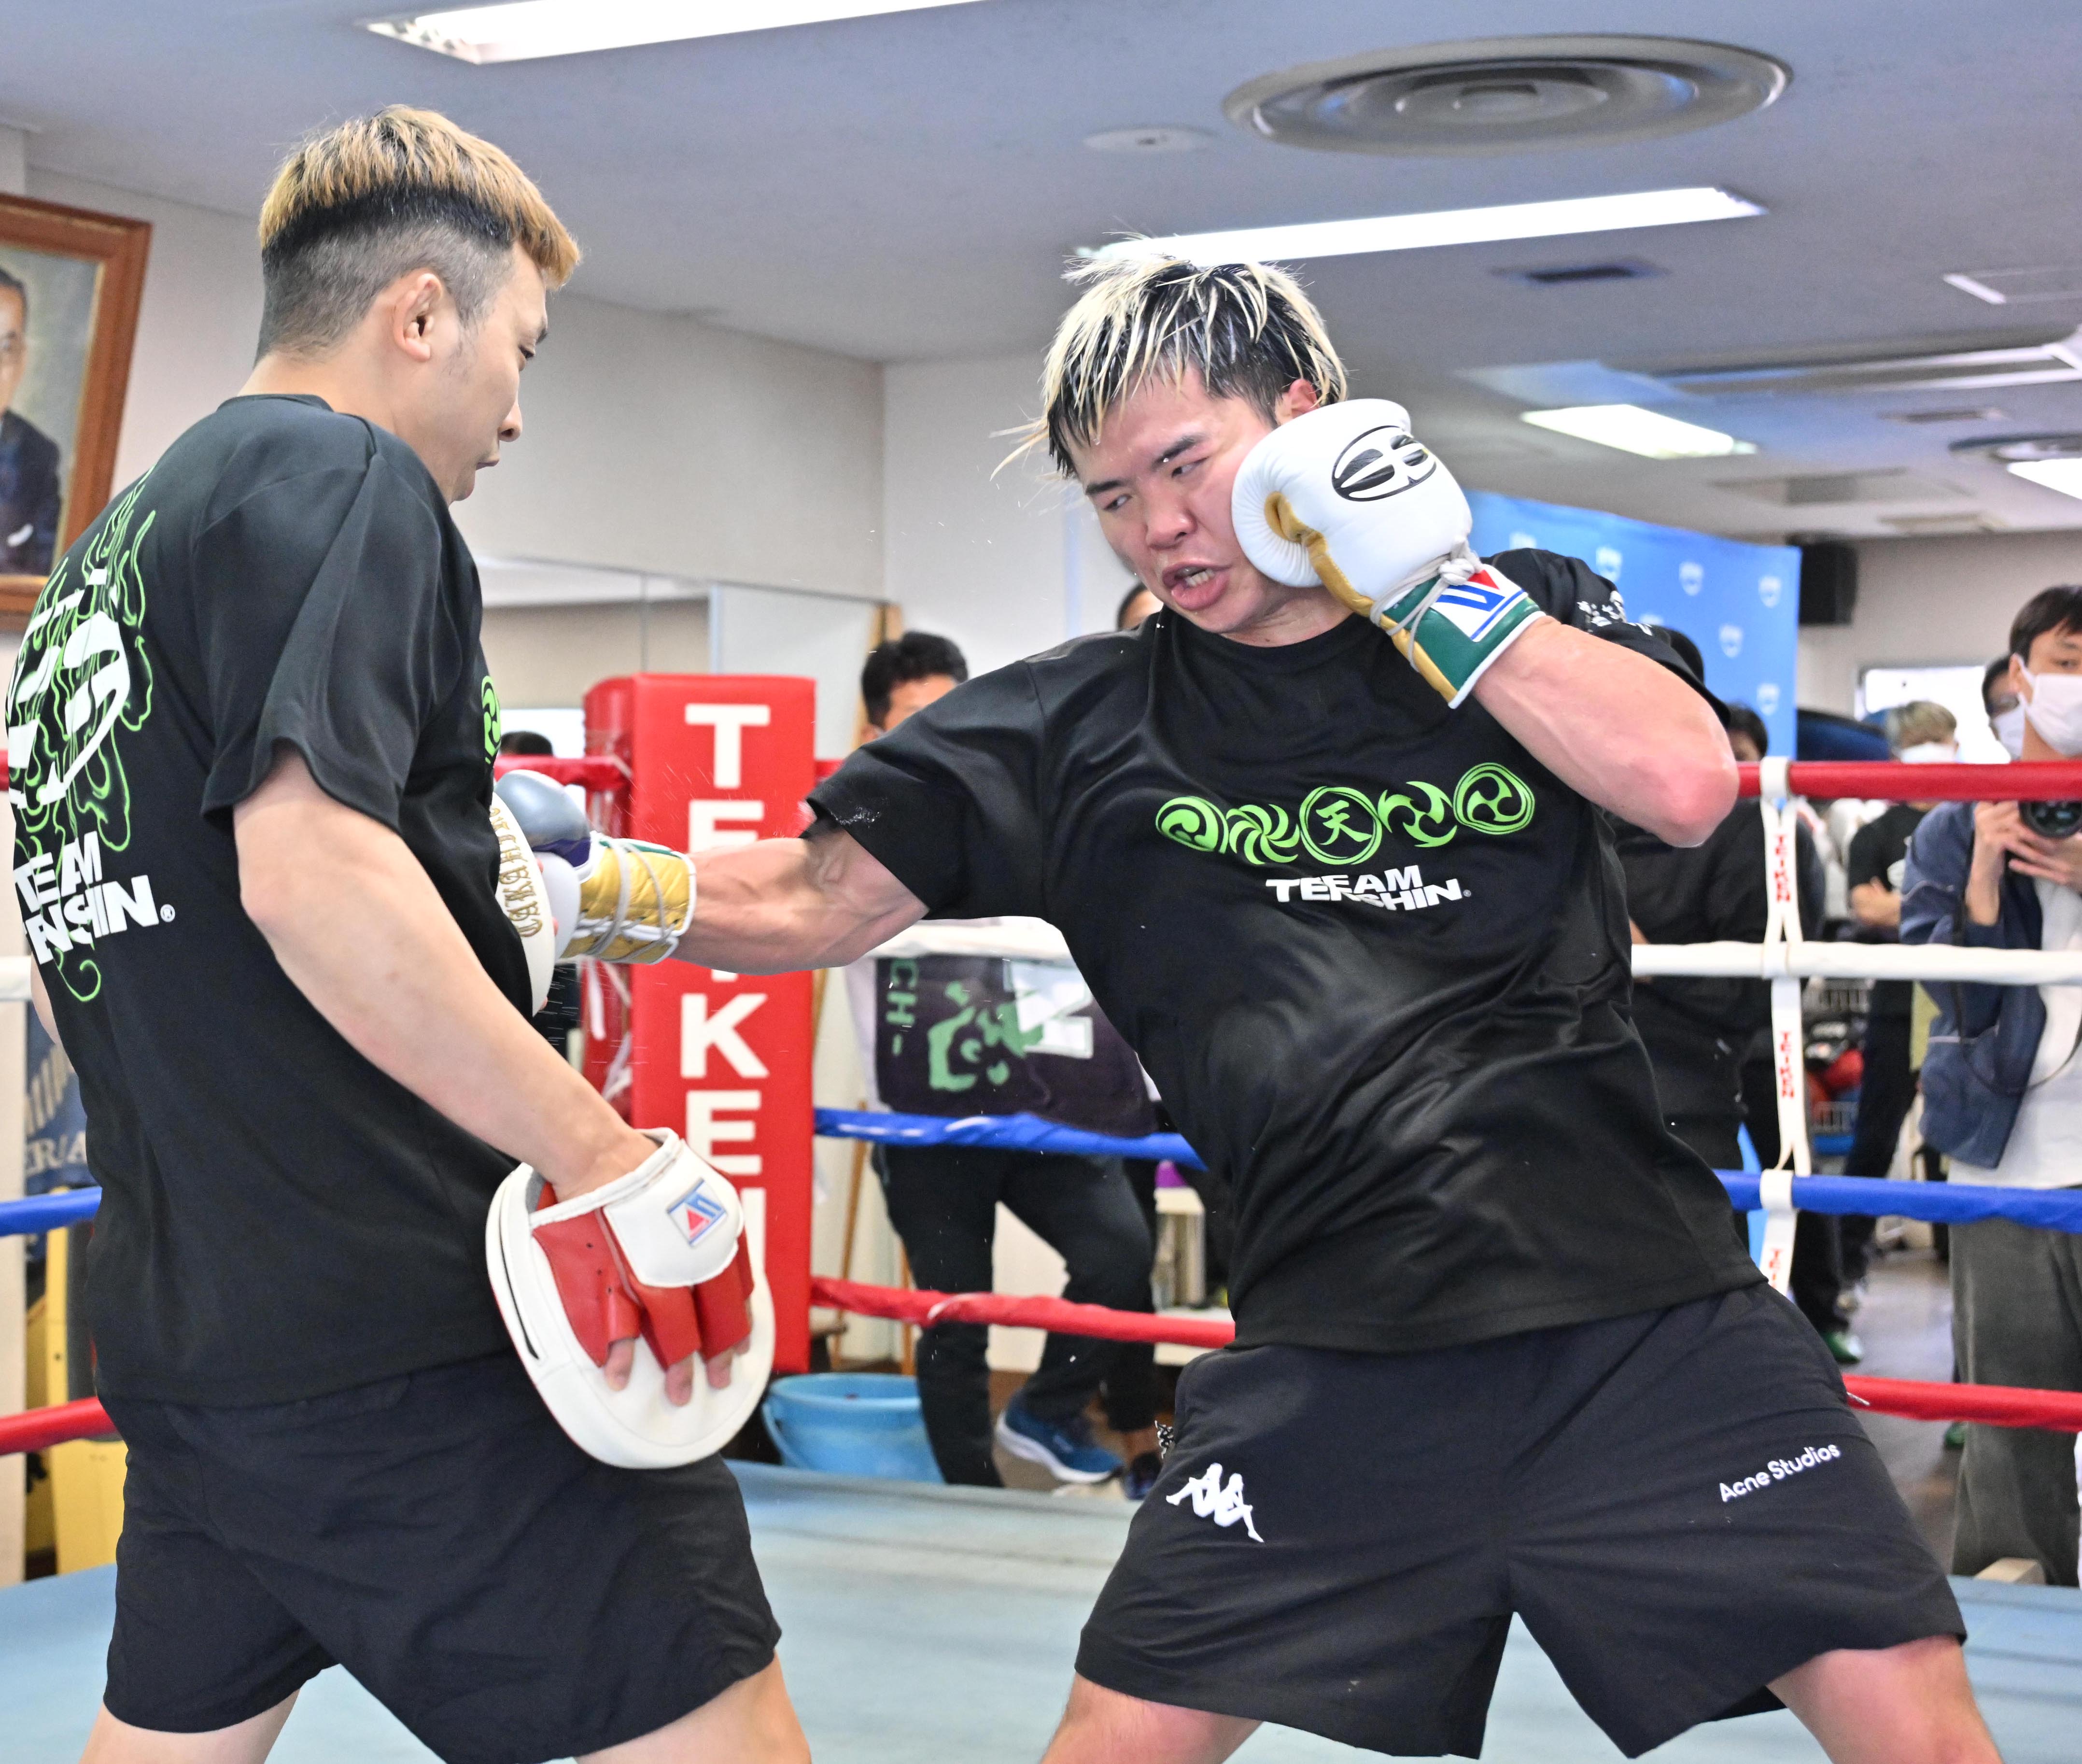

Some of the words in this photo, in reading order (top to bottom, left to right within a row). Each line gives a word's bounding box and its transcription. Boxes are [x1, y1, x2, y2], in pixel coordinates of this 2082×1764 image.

[1316, 800, 1372, 845] 天
[680, 704, 770, 1273] TEKE
[1719, 1472, 1771, 1502] Acne
[1767, 1444, 1841, 1480] Studios
